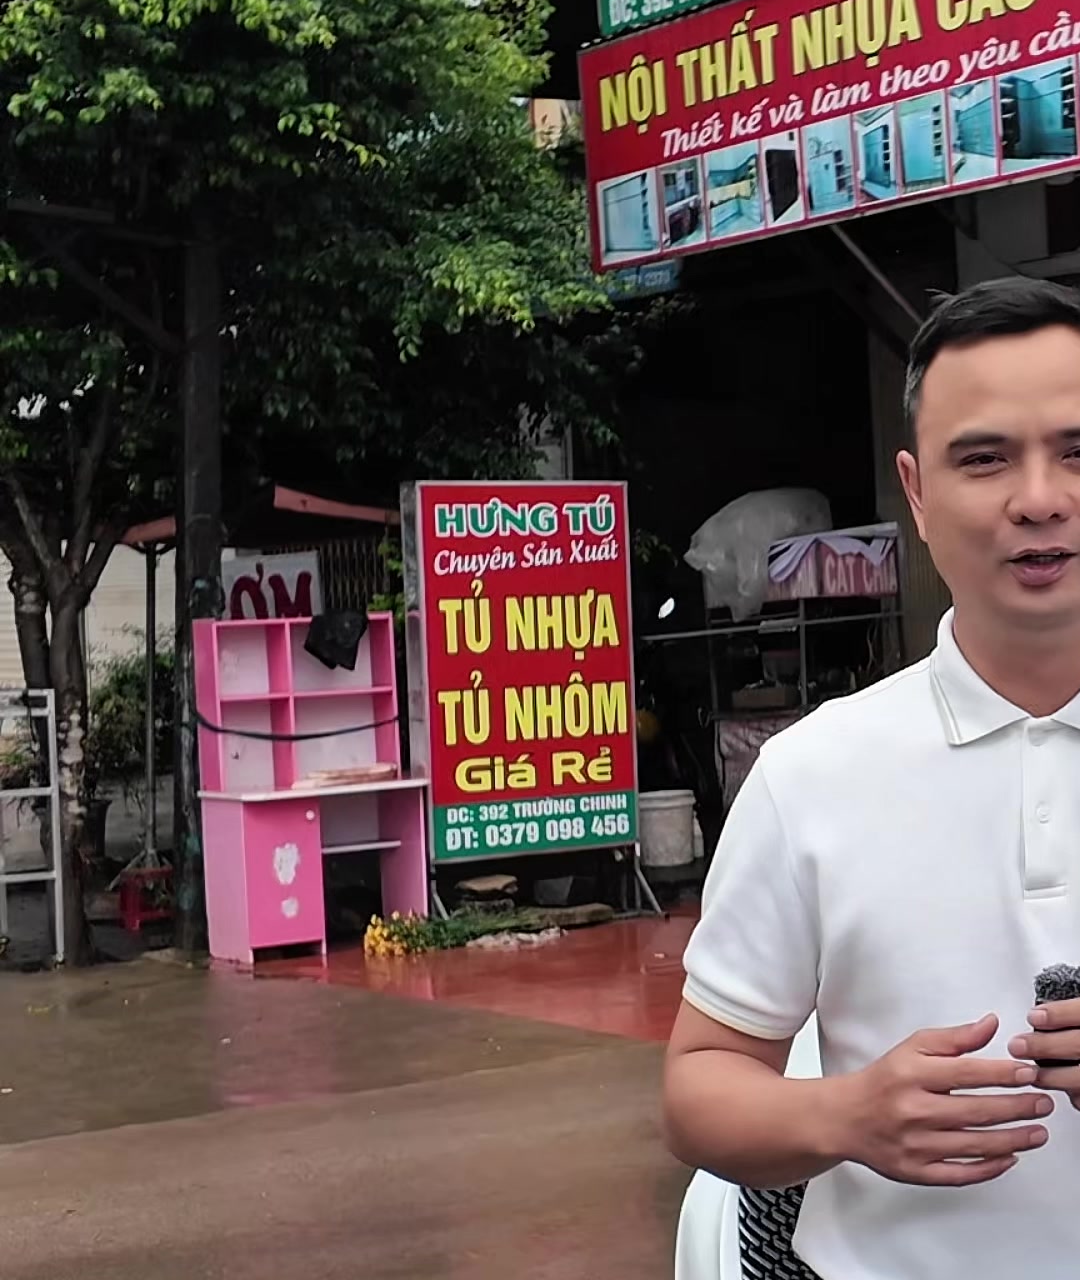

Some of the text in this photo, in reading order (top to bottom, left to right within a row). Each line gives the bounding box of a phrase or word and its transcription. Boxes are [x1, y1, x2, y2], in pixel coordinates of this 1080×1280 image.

[600, 54, 667, 135] NỘI
[676, 9, 779, 108] THẤT
[661, 111, 723, 158] Thiết
[730, 97, 769, 140] kế
[769, 93, 804, 124] và
[811, 82, 872, 116] làm
[880, 59, 950, 98] theo
[955, 37, 1022, 84] yêu
[434, 493, 616, 538] HƯNG TÚ
[434, 534, 619, 577] Chuyên Sản Xuất
[438, 578, 620, 660] TỦ NHỰA
[437, 670, 628, 746] TỦ NHÔM
[455, 746, 612, 793] Giá Rẻ
[446, 793, 627, 825] ĐC: 392 TRƯỜNG CHINH
[446, 813, 630, 852] ĐT: 0379 098 456
